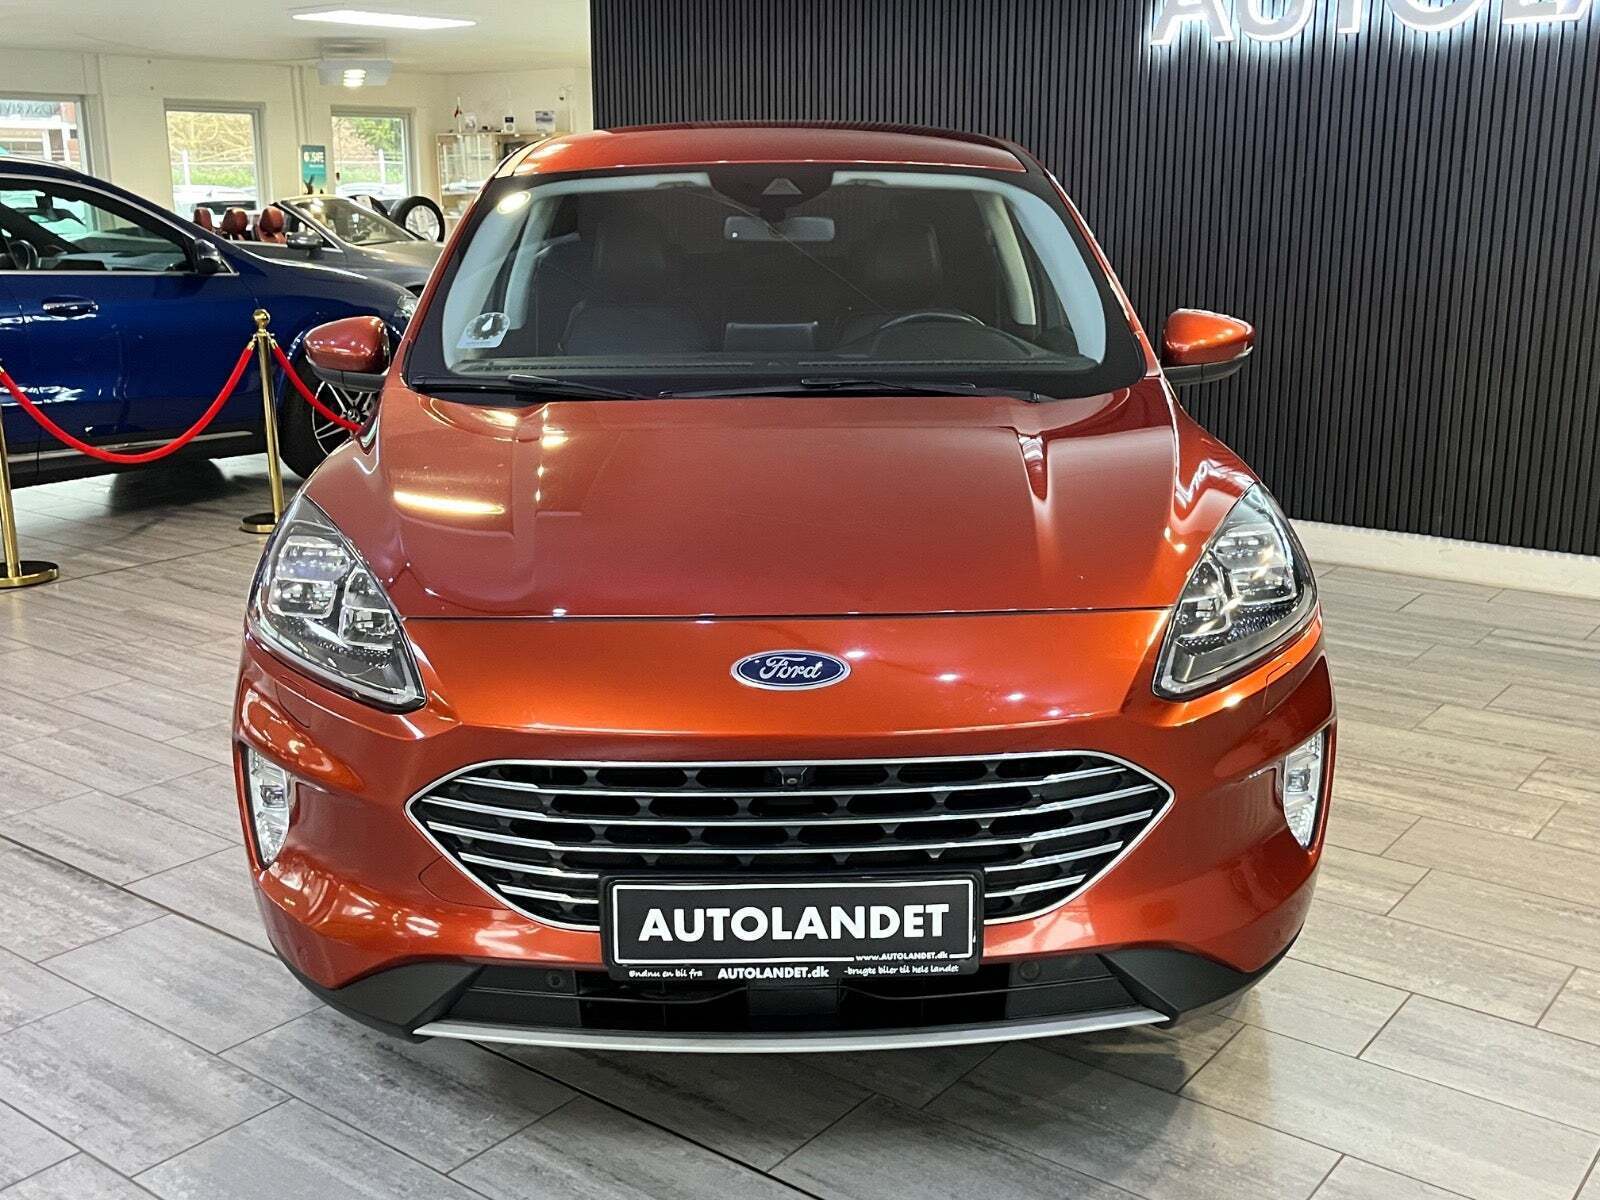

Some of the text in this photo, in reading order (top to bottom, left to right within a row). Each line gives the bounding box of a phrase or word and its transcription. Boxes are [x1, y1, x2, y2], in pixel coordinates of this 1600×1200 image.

[759, 656, 823, 679] Ford
[638, 904, 949, 942] AUTOLANDET
[855, 951, 948, 961] www.AUTOLANDET.dk
[662, 970, 674, 978] en
[675, 968, 687, 978] bil
[688, 968, 703, 979] fra
[718, 967, 830, 979] AUTOLANDET.dk
[878, 966, 898, 975] biler
[899, 965, 910, 975] til
[912, 965, 929, 974] hele
[930, 964, 959, 973] landet
